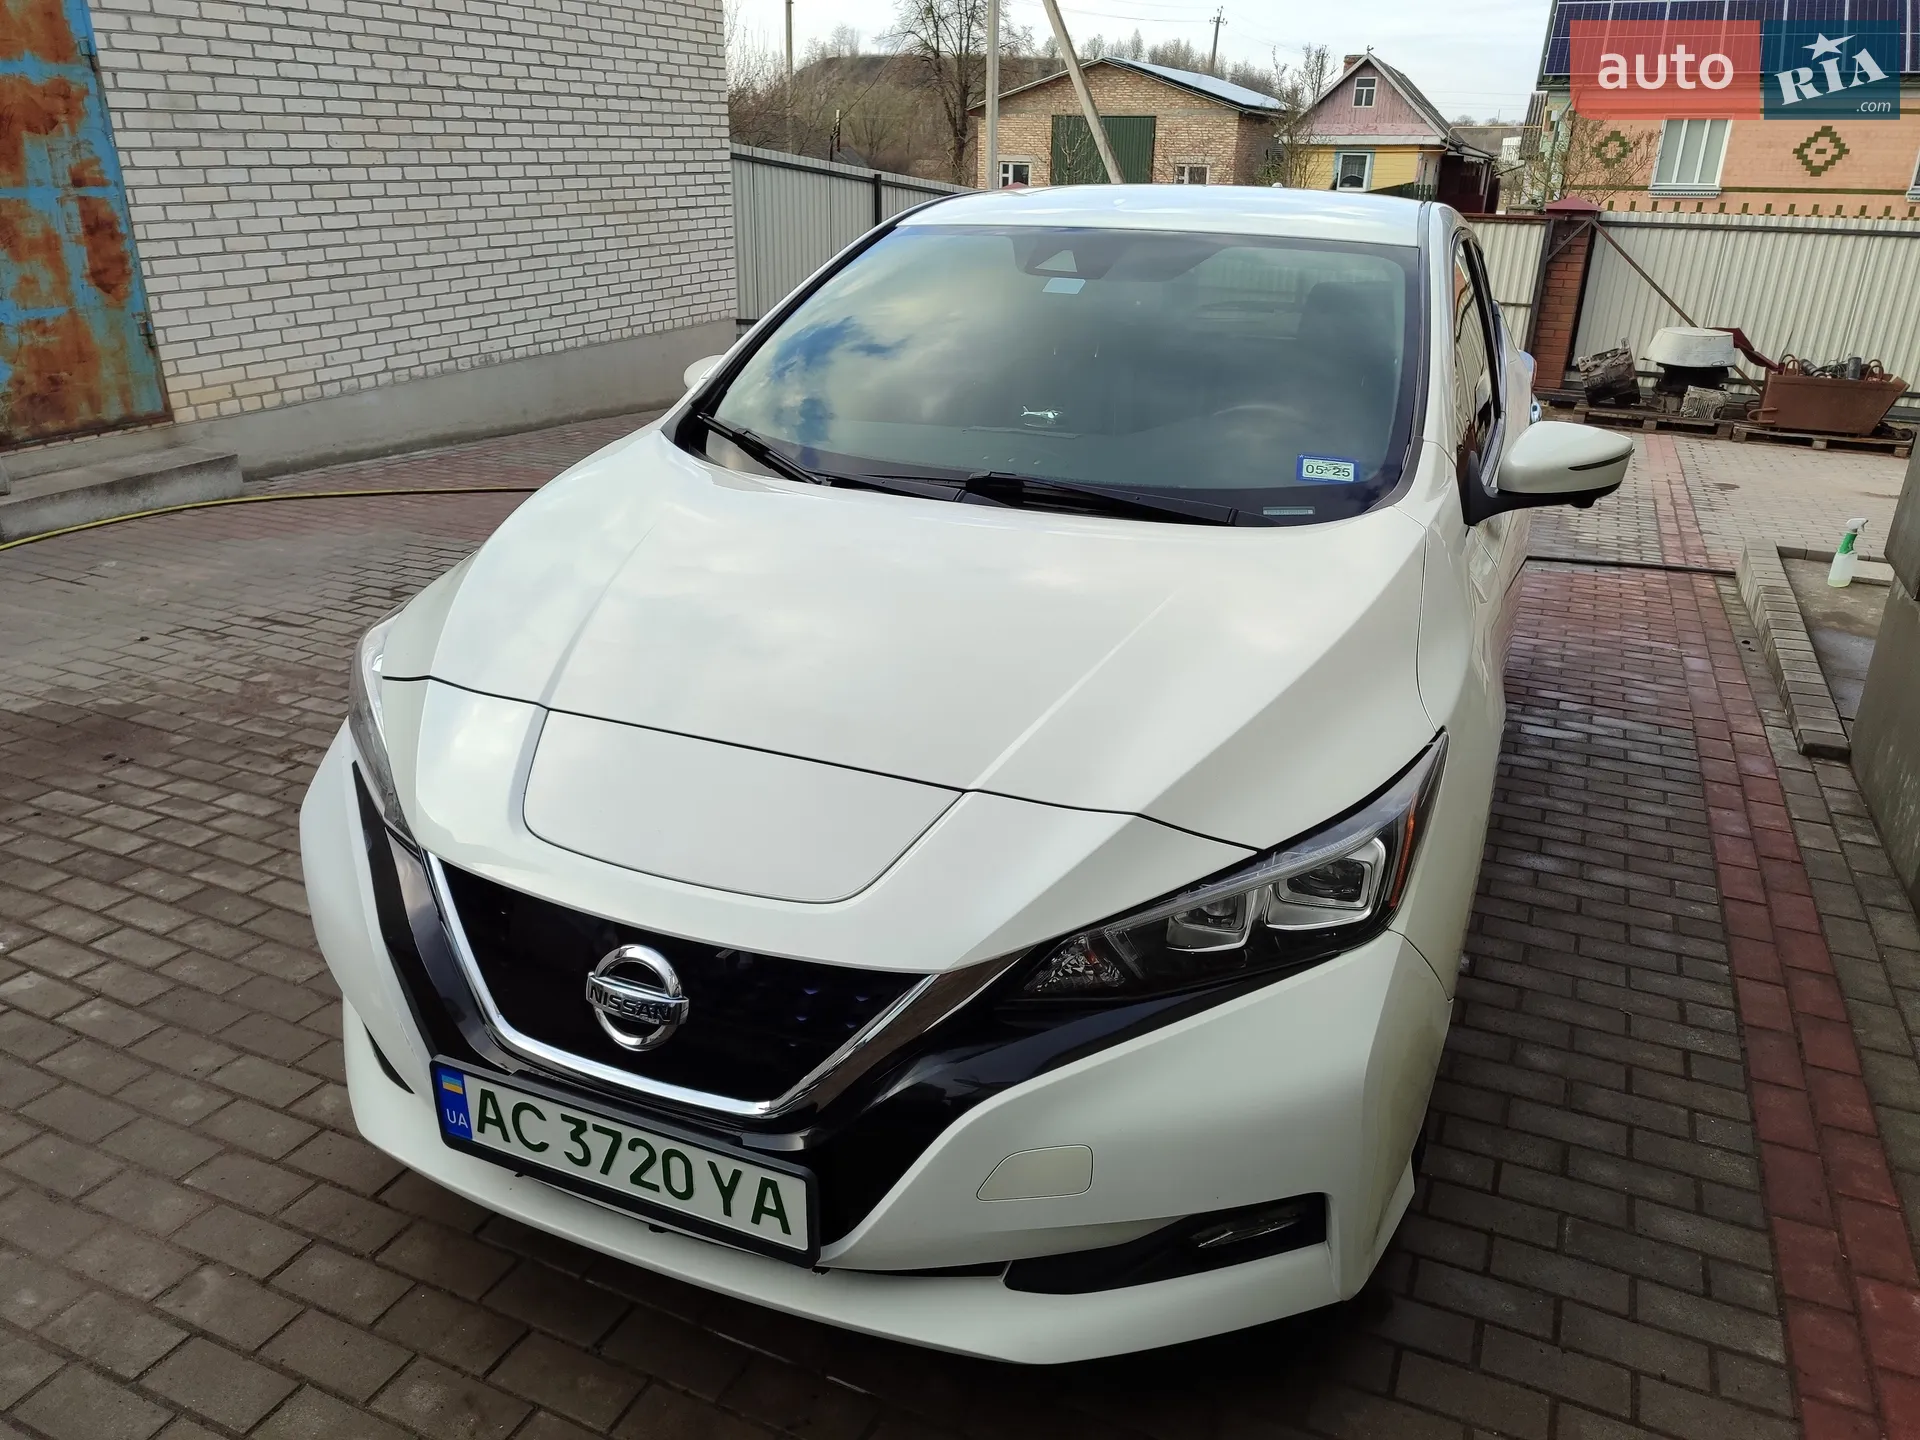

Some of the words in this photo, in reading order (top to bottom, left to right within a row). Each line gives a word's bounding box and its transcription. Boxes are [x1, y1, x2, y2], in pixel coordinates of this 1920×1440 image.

[1305, 464, 1324, 475] 05
[1332, 466, 1351, 477] 25
[590, 985, 672, 1021] NISSAN
[446, 1108, 468, 1129] UA
[477, 1088, 550, 1153] AC
[560, 1113, 694, 1200] 3720
[707, 1160, 791, 1235] YA
